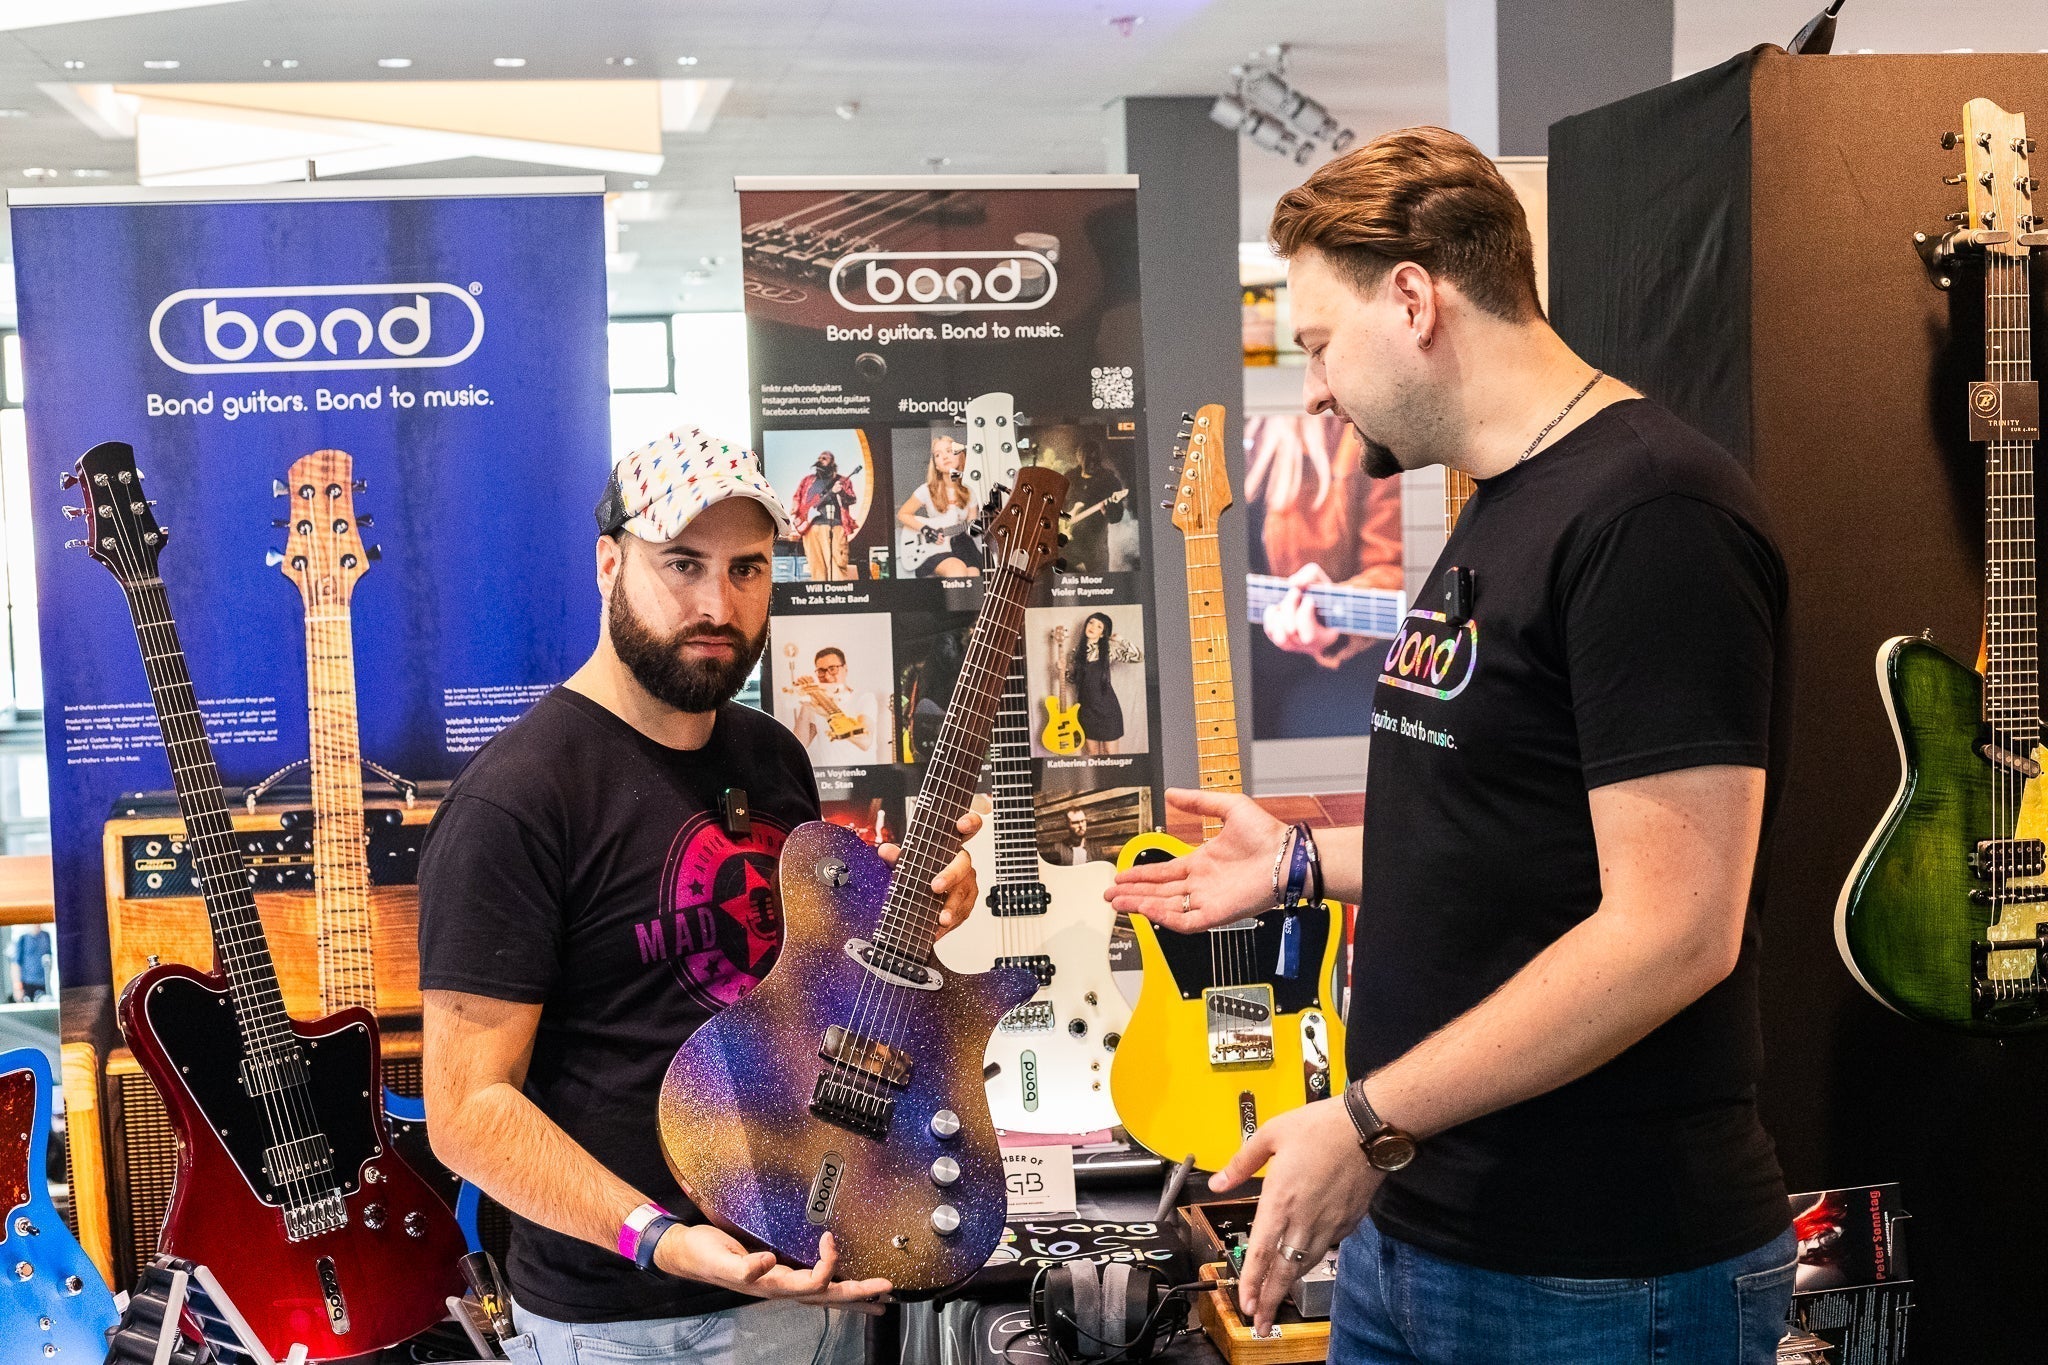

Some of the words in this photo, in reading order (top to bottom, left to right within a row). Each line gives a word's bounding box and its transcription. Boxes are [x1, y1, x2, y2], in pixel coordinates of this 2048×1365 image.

[866, 258, 1022, 304] bond
[203, 294, 431, 361] bond
[826, 324, 872, 341] Bond
[878, 324, 937, 345] guitars.
[942, 322, 987, 339] Bond
[992, 322, 1010, 338] to
[1015, 322, 1064, 338] music.
[761, 384, 842, 394] linktr.ee/bondguitars
[147, 391, 213, 416] Bond
[222, 390, 308, 420] guitars.
[316, 385, 382, 411] Bond
[390, 385, 415, 408] to
[424, 384, 494, 408] music.
[762, 395, 870, 406] instagram.com/bond.guitars
[762, 406, 870, 416] facebook.com/bondtomusic
[941, 580, 964, 588] Tasha
[967, 580, 972, 588] S
[1061, 576, 1079, 584] Axis
[1080, 576, 1103, 584] Moor
[806, 584, 822, 592] Will
[824, 583, 853, 592] Dowell
[791, 596, 806, 605] The
[808, 596, 824, 604] Zak
[825, 595, 846, 604] Saltz
[847, 594, 869, 603] Band
[1384, 619, 1462, 685] bond
[1401, 716, 1418, 738] Bond
[1418, 721, 1426, 741] to
[1427, 729, 1457, 749] music.
[1047, 759, 1086, 768] Katherine
[1087, 758, 1133, 767] Driedsugar
[827, 768, 866, 779] Voytenko
[821, 781, 833, 789] Dr.
[835, 781, 853, 789] Stan
[634, 906, 718, 965] MAD
[1023, 1061, 1036, 1102] bond
[1000, 1155, 1026, 1163] MBER
[1030, 1157, 1044, 1166] OF
[812, 1163, 838, 1213] bond
[1870, 1190, 1883, 1243] Sonntag
[1025, 1223, 1158, 1234] bond
[1030, 1239, 1081, 1256] to
[1875, 1244, 1886, 1280] Peter
